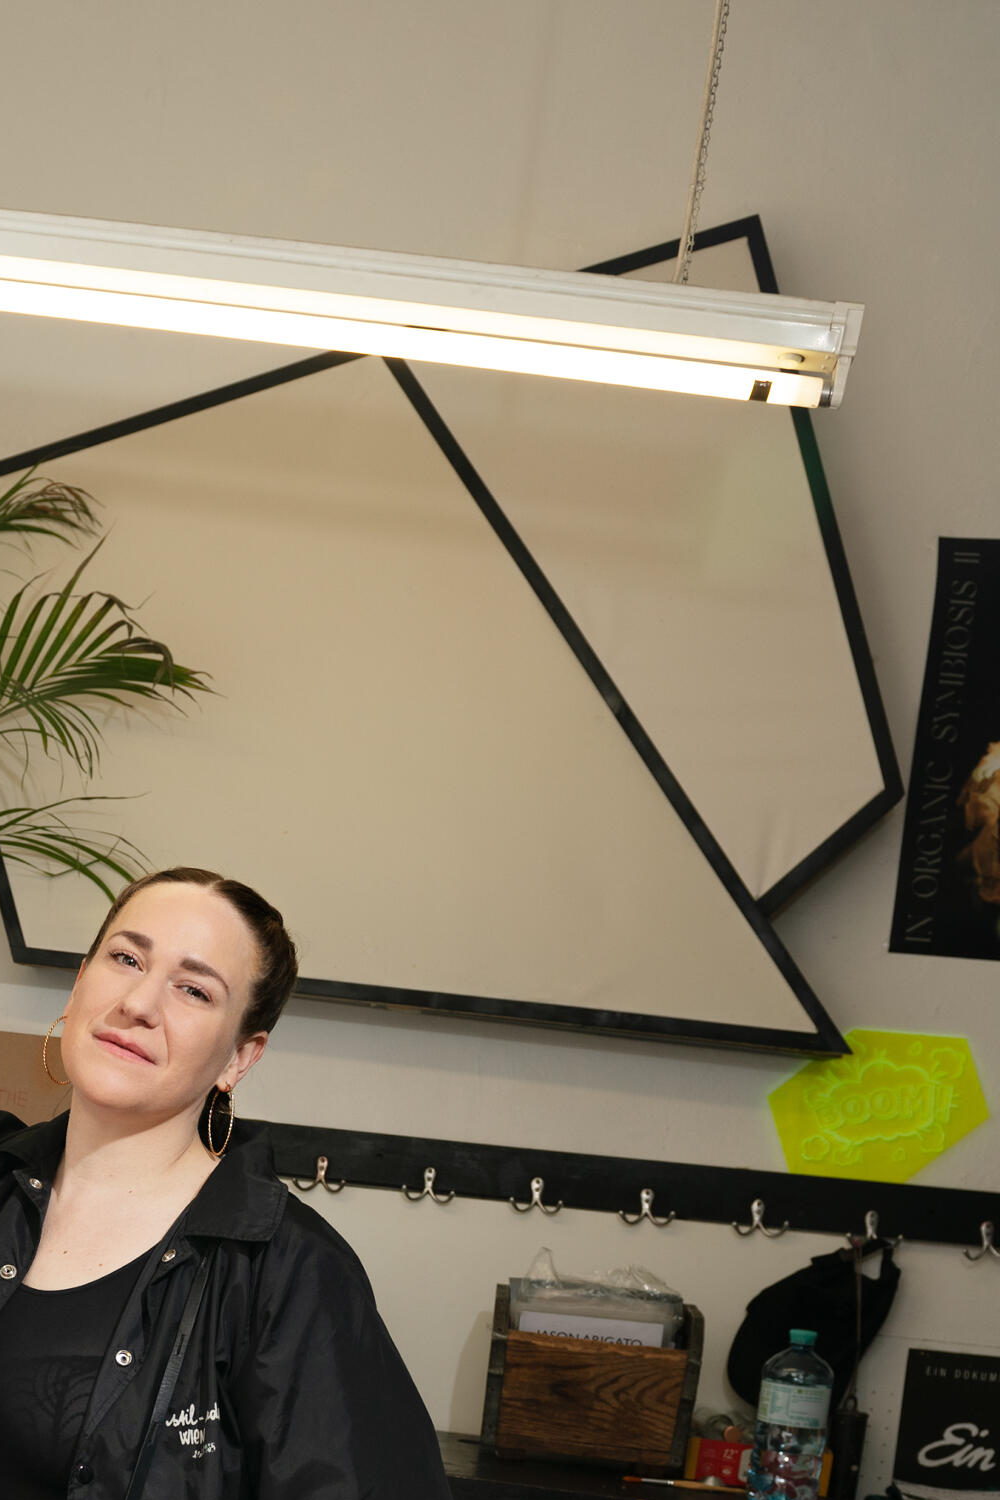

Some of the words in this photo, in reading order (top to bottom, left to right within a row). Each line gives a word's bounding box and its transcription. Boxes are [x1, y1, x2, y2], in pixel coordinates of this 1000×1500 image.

[953, 551, 981, 564] II
[932, 579, 978, 744] SYMBIOSIS
[911, 761, 954, 899] ORGANIC
[904, 915, 935, 943] IN
[925, 1365, 947, 1377] EIN
[953, 1367, 1000, 1382] DOKUM
[916, 1422, 997, 1472] Ein
